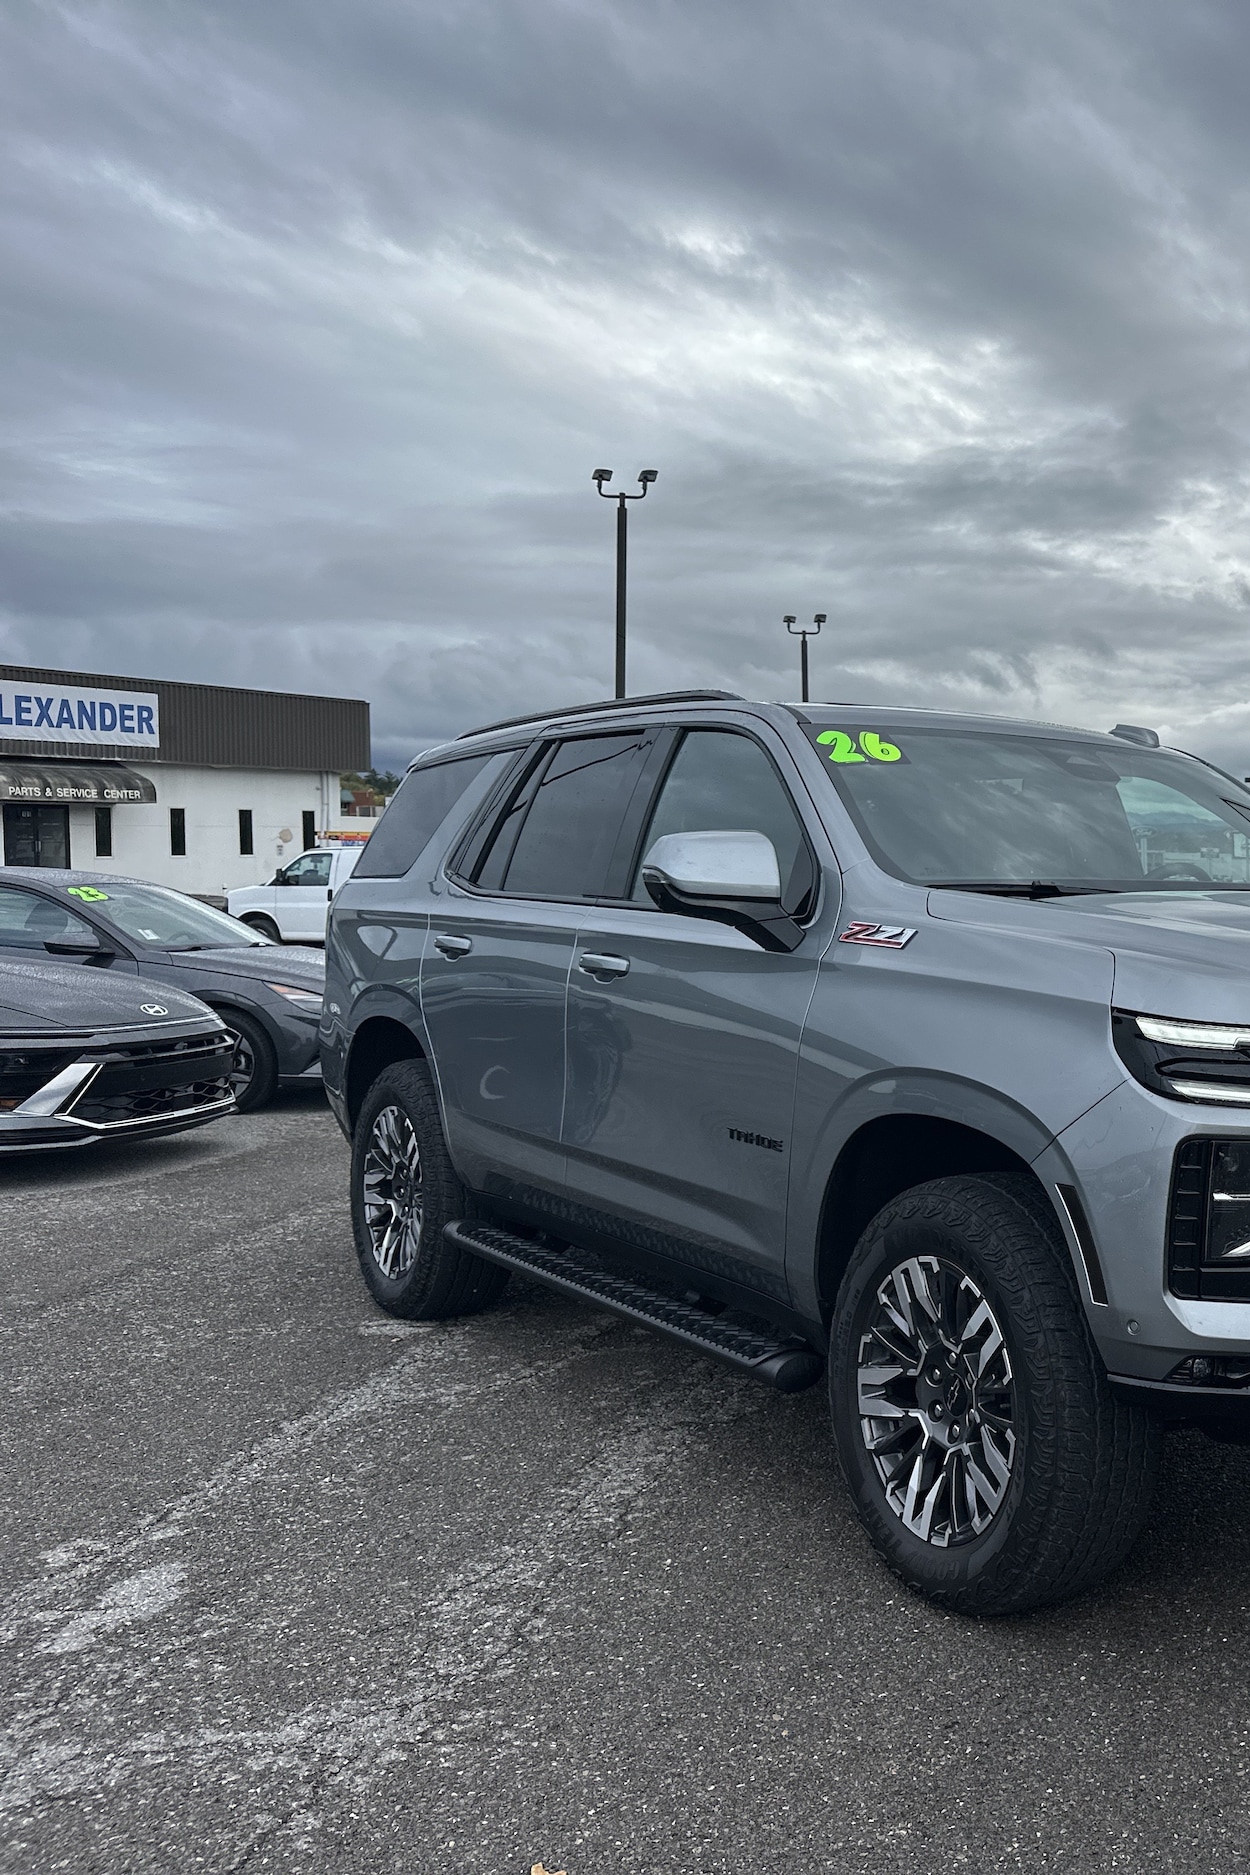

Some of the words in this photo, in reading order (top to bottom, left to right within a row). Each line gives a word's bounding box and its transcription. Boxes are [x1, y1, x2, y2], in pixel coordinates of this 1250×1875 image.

[815, 730, 902, 764] 26
[8, 786, 41, 797] PARTS
[45, 787, 53, 797] &
[56, 787, 98, 798] SERVICE
[103, 788, 141, 799] CENTER
[839, 920, 919, 949] Z71
[726, 1127, 784, 1153] TAHOE
